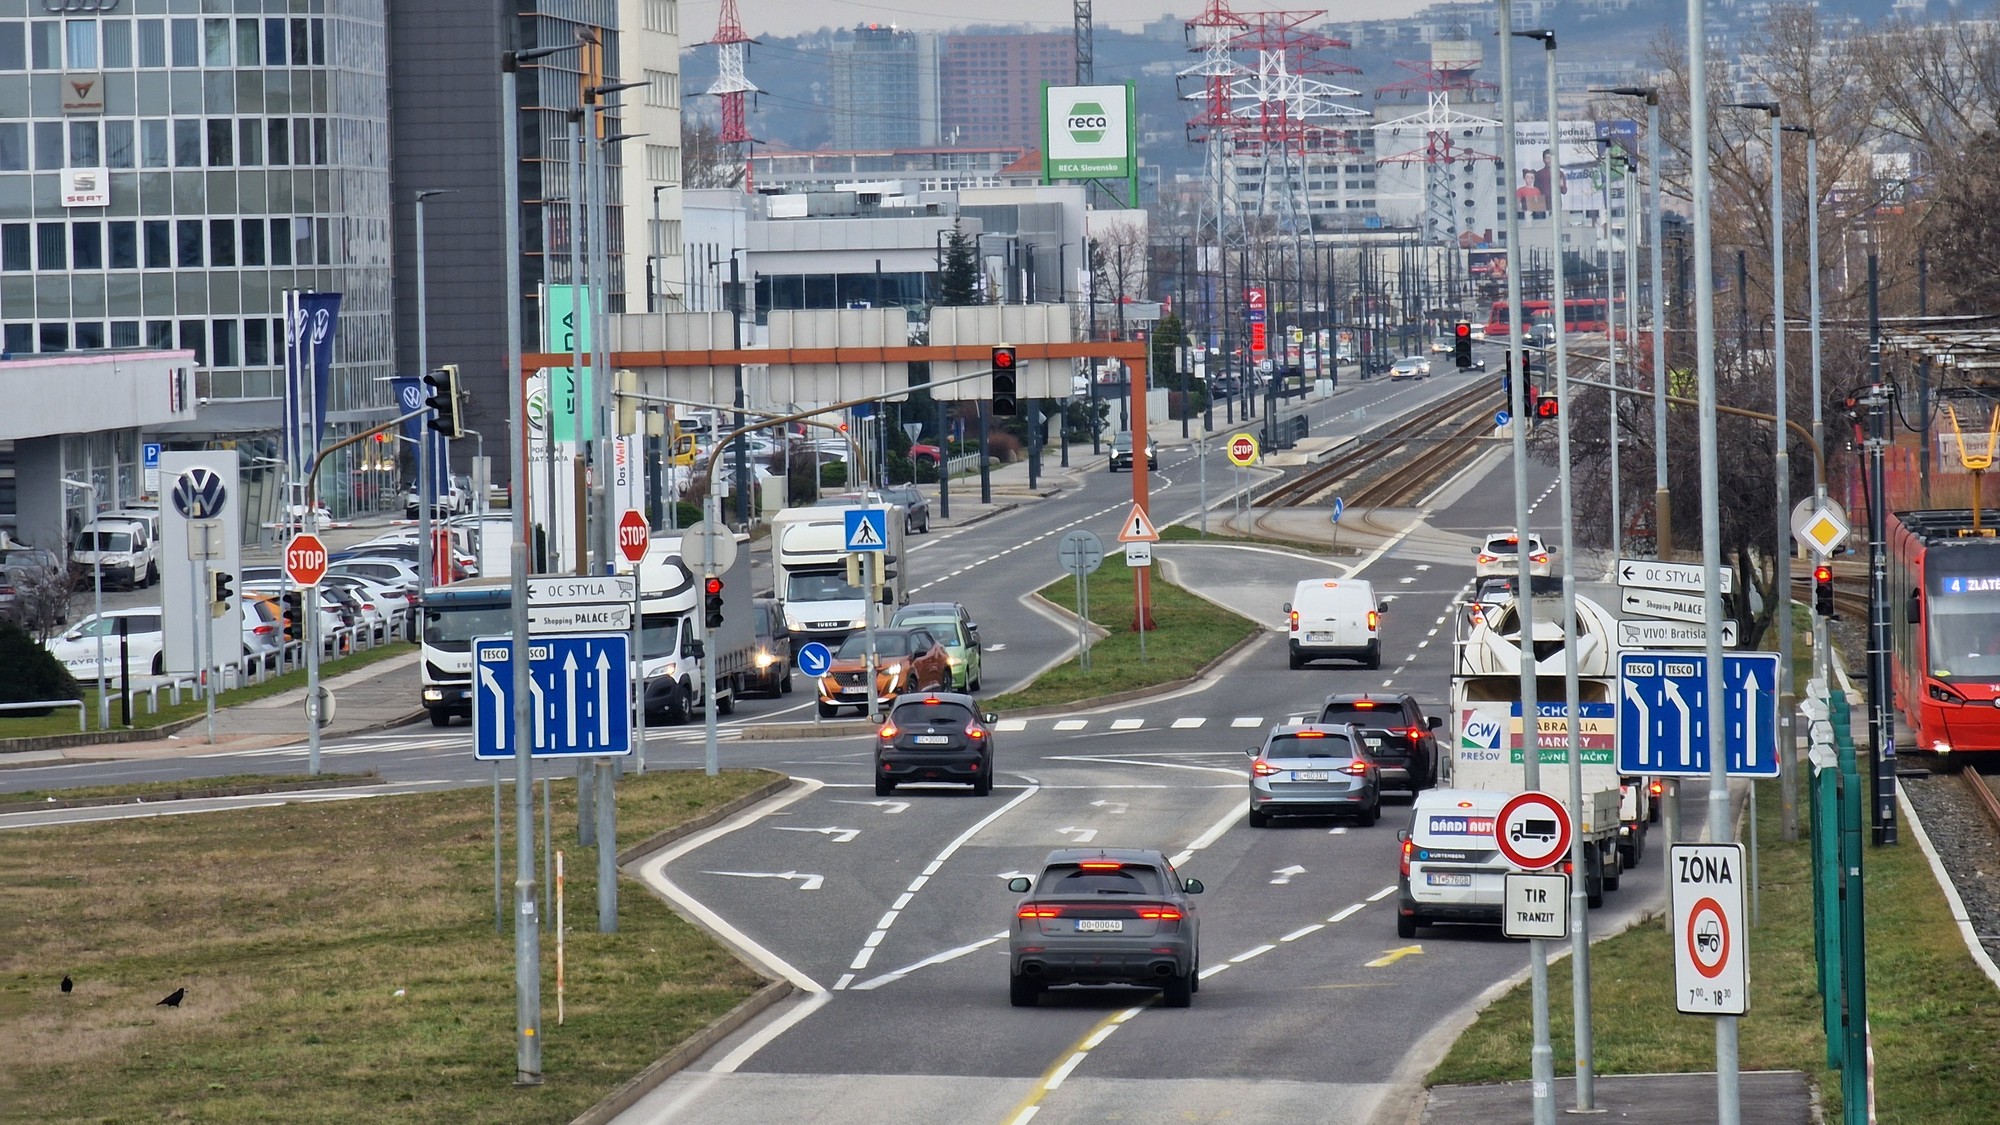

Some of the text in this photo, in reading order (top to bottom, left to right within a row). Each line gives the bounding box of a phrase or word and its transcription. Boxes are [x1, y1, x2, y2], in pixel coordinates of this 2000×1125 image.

[1068, 117, 1107, 128] reca
[1058, 163, 1119, 172] RECA Slovensko
[148, 447, 156, 460] P
[1233, 444, 1253, 455] STOP
[616, 467, 626, 487] Das
[620, 526, 646, 546] STOP
[289, 550, 324, 570] STOP
[1646, 568, 1701, 584] OC STYLA
[548, 584, 605, 597] OC STYLA
[1951, 579, 1960, 591] 4
[1646, 600, 1702, 615] Shopping PALACE
[543, 612, 608, 626] Shopping PALACE
[1643, 627, 1668, 639] VIVO!
[483, 650, 507, 659] TESCO
[529, 649, 545, 658] SCO
[1628, 665, 1653, 675] TESCO
[1668, 665, 1693, 675] TESCO
[1467, 723, 1496, 737] CW
[1461, 750, 1500, 761] PREŠOV
[1431, 819, 1467, 832] BÁRDI
[1679, 850, 1733, 884] ZÓNA
[1525, 889, 1547, 903] TIR
[1517, 911, 1555, 923] TRANZIT
